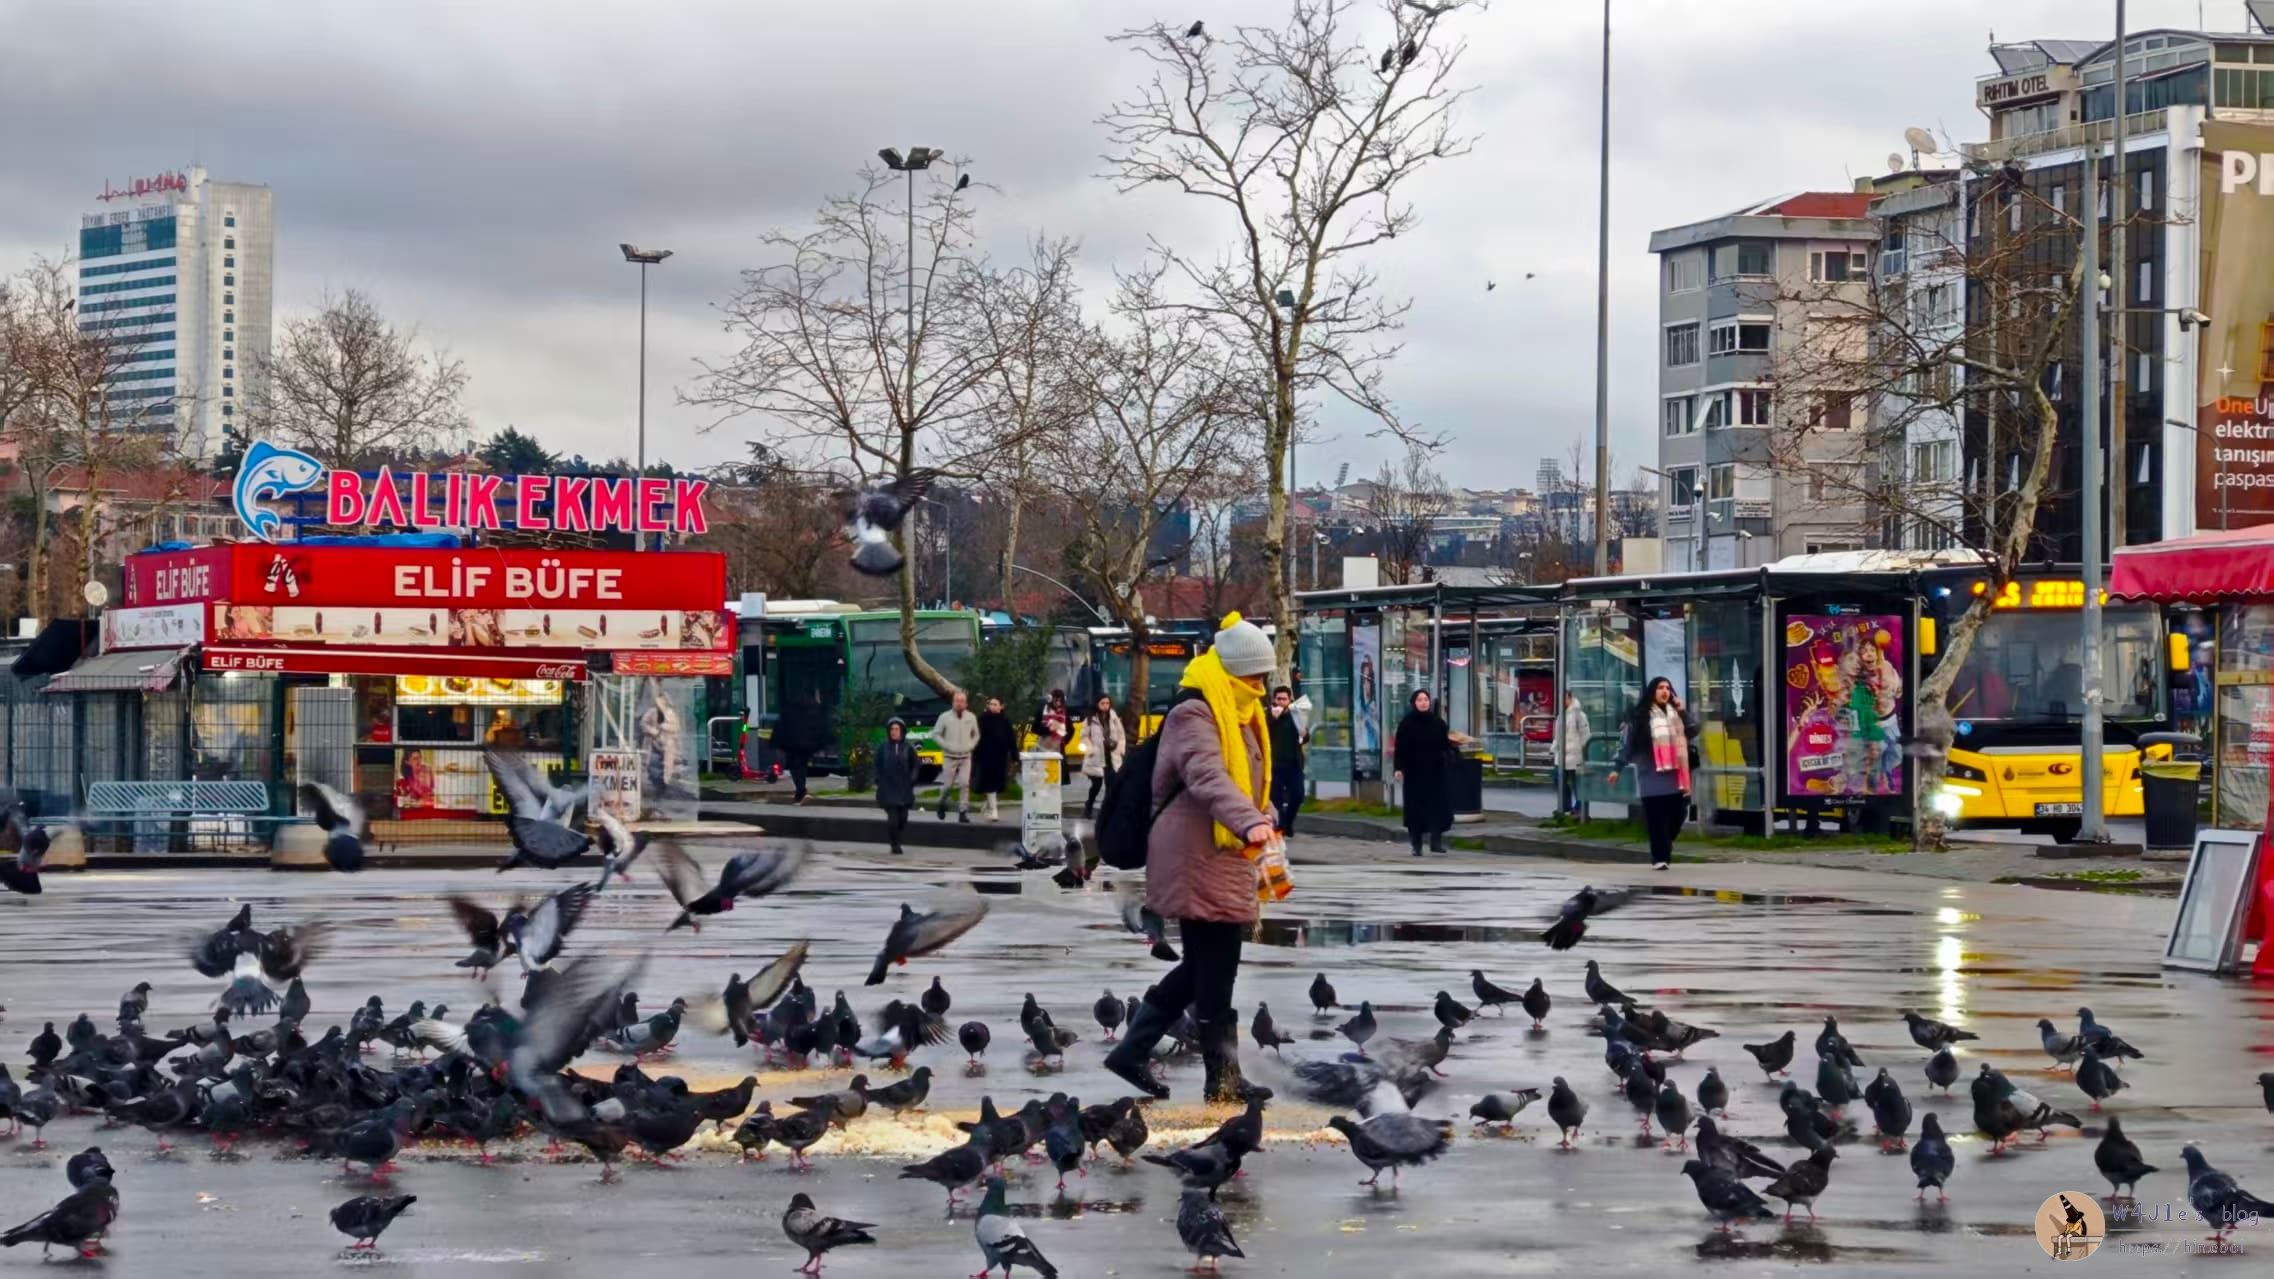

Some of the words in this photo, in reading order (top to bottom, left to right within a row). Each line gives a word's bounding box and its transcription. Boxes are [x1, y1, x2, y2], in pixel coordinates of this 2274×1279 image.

[2022, 75, 2049, 95] OTEL
[327, 465, 503, 530] BALIK
[517, 475, 709, 534] EKMEK
[156, 560, 179, 600] ELİF
[181, 558, 209, 598] BÜFE
[395, 557, 491, 597] ELİF
[506, 558, 622, 599] BÜFE
[211, 654, 242, 667] ELİF
[246, 656, 284, 669] BÜFE
